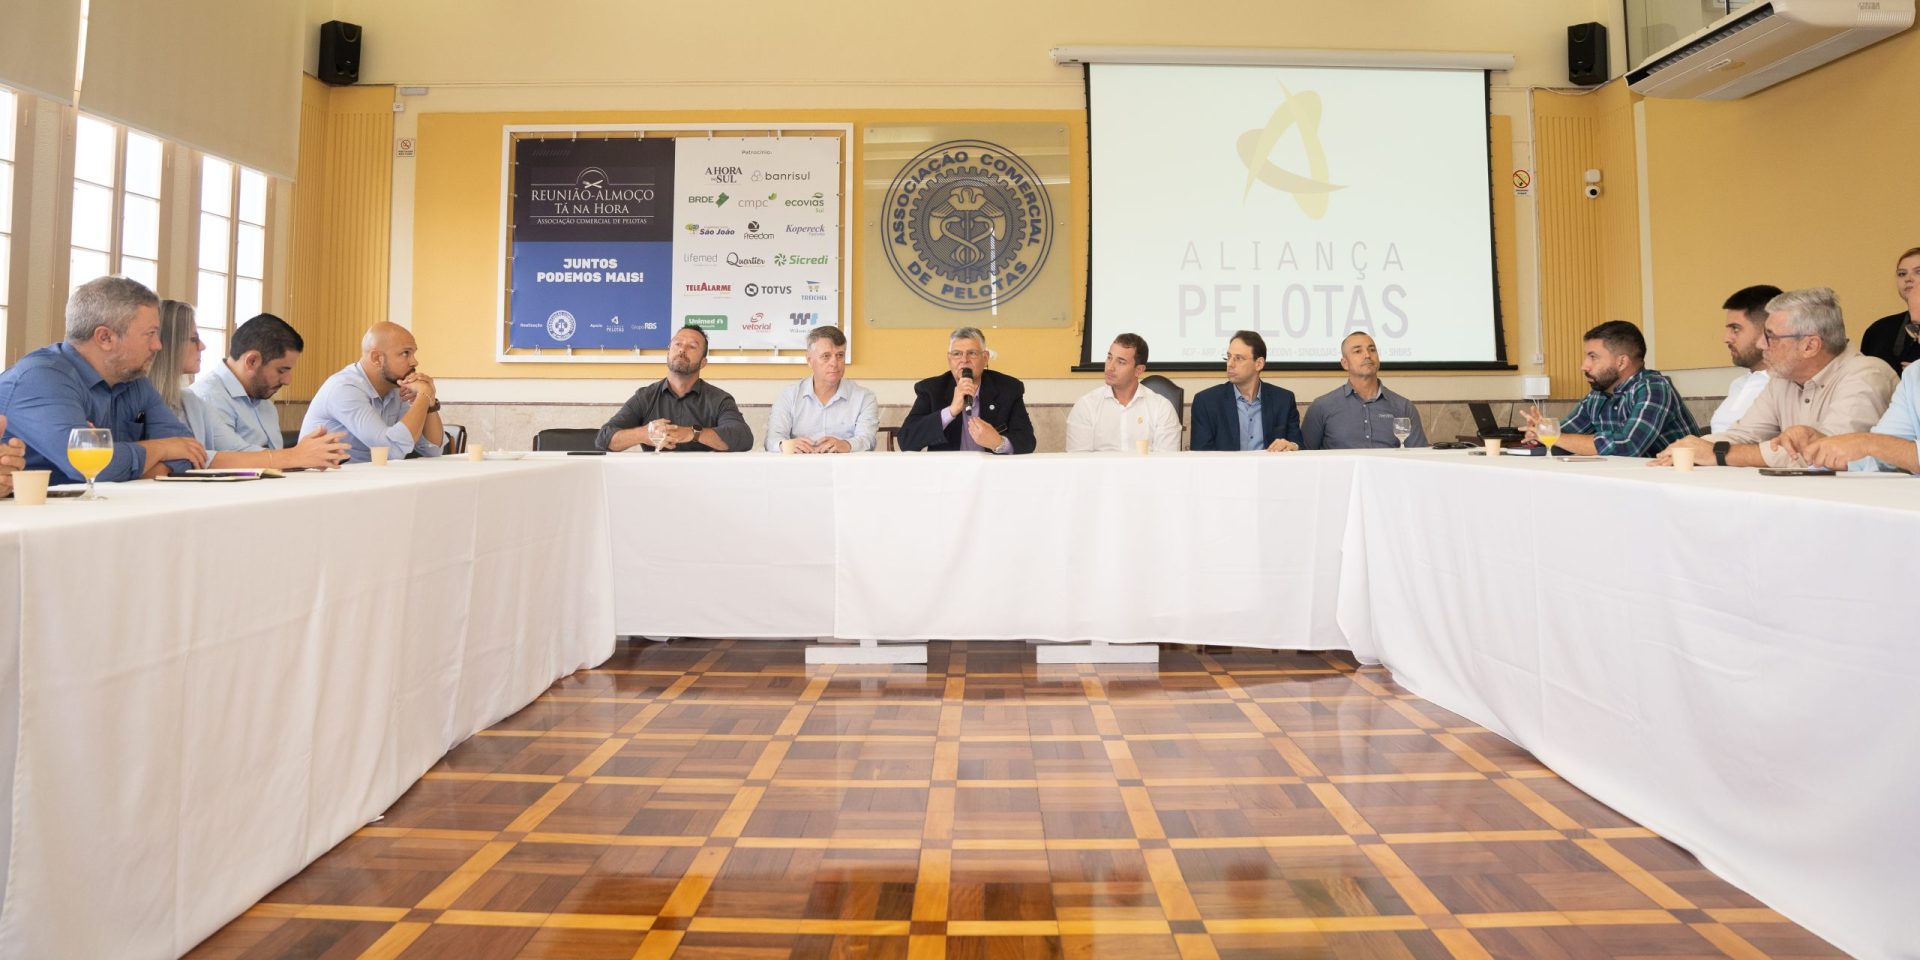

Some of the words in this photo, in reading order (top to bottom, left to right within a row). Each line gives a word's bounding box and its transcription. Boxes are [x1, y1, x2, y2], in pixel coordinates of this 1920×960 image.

[716, 175, 737, 183] SUL
[765, 171, 811, 181] banrisul
[531, 188, 655, 203] REUNIÃO-ALMOÇO
[893, 151, 969, 246] ASSOCIAÇÃO
[980, 154, 1042, 247] COMERCIAL
[738, 199, 768, 208] cmpc
[785, 199, 824, 207] ecovias
[786, 223, 825, 235] Kopereck
[563, 258, 618, 269] JUNTOS
[726, 252, 766, 268] Quartier
[789, 254, 829, 265] Sicredi
[1180, 240, 1405, 281] ALIANÇA
[537, 272, 602, 283] PODEMOS
[605, 272, 644, 283] MAIS!
[907, 260, 932, 286] DE
[941, 261, 1028, 299] PELOTAS
[761, 286, 792, 295] TOTVS
[1178, 283, 1409, 339] PELOTAS
[742, 323, 772, 331] vetorial
